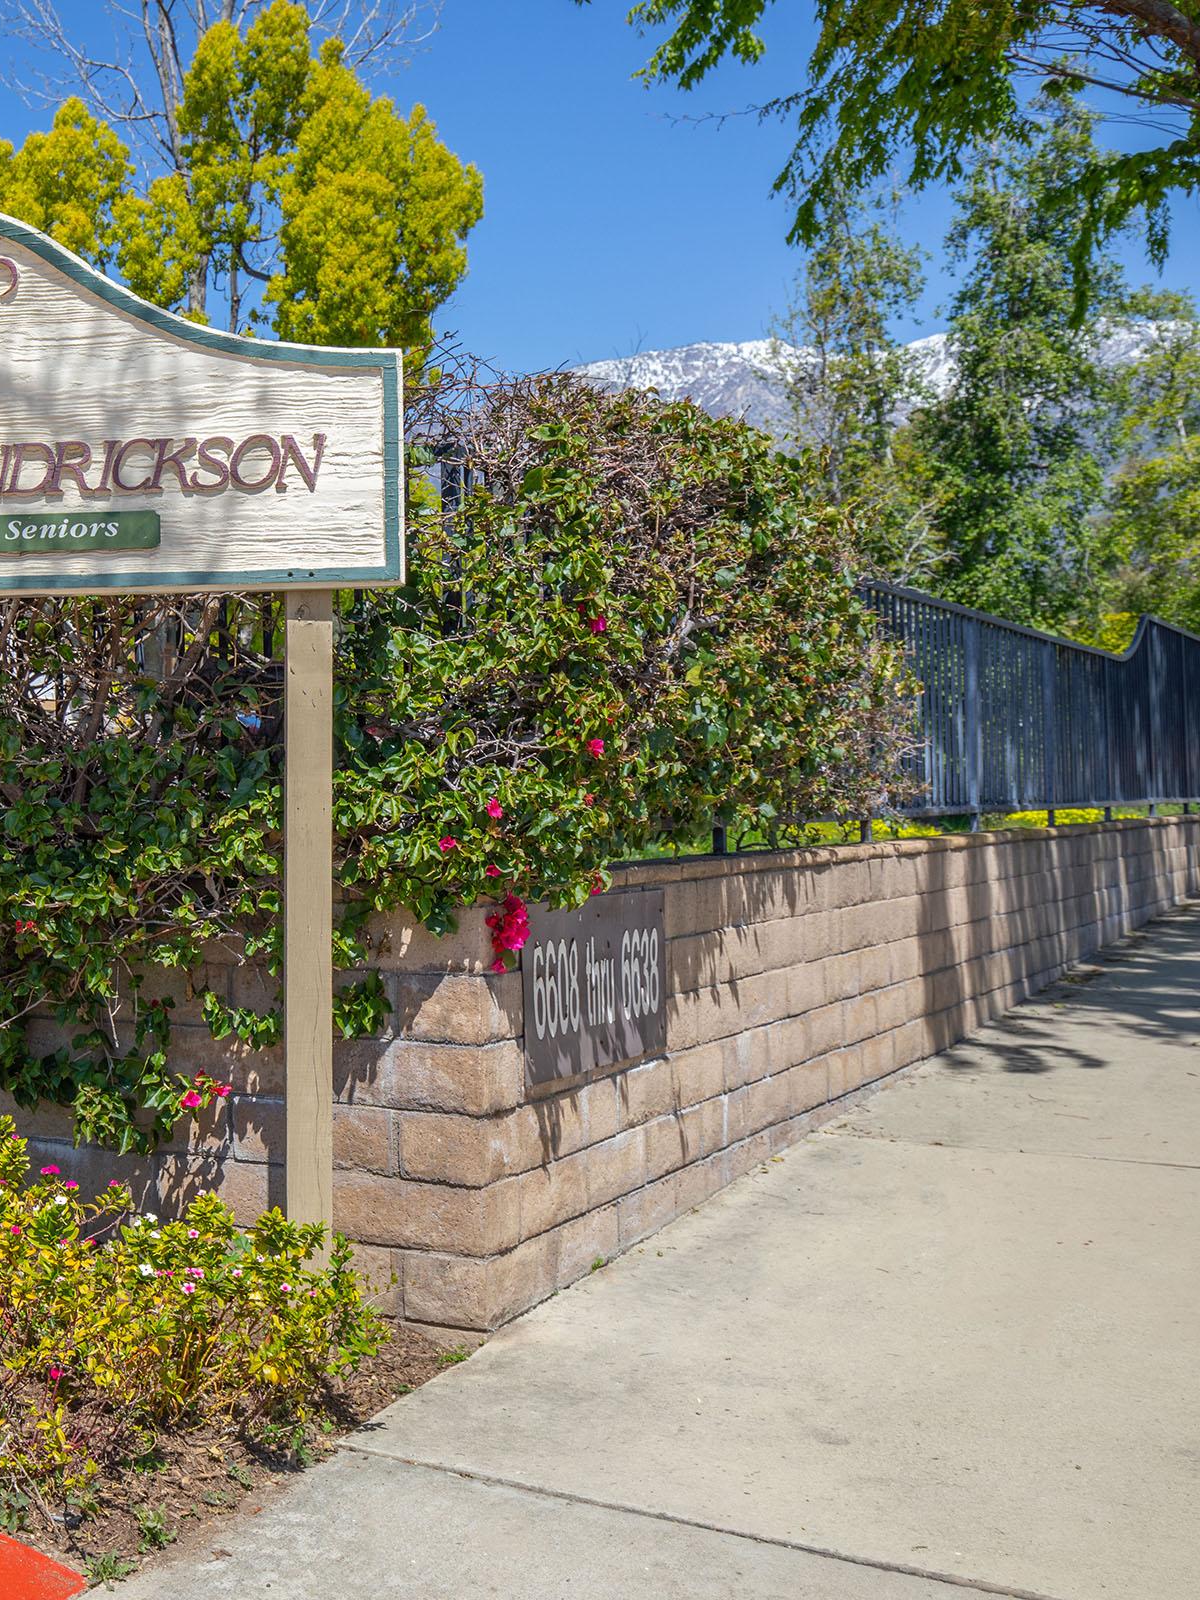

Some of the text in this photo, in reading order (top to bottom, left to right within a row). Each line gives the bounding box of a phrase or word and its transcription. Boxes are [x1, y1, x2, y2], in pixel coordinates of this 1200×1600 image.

[5, 519, 119, 541] Seniors
[533, 928, 660, 1040] 6608 thru 6638
